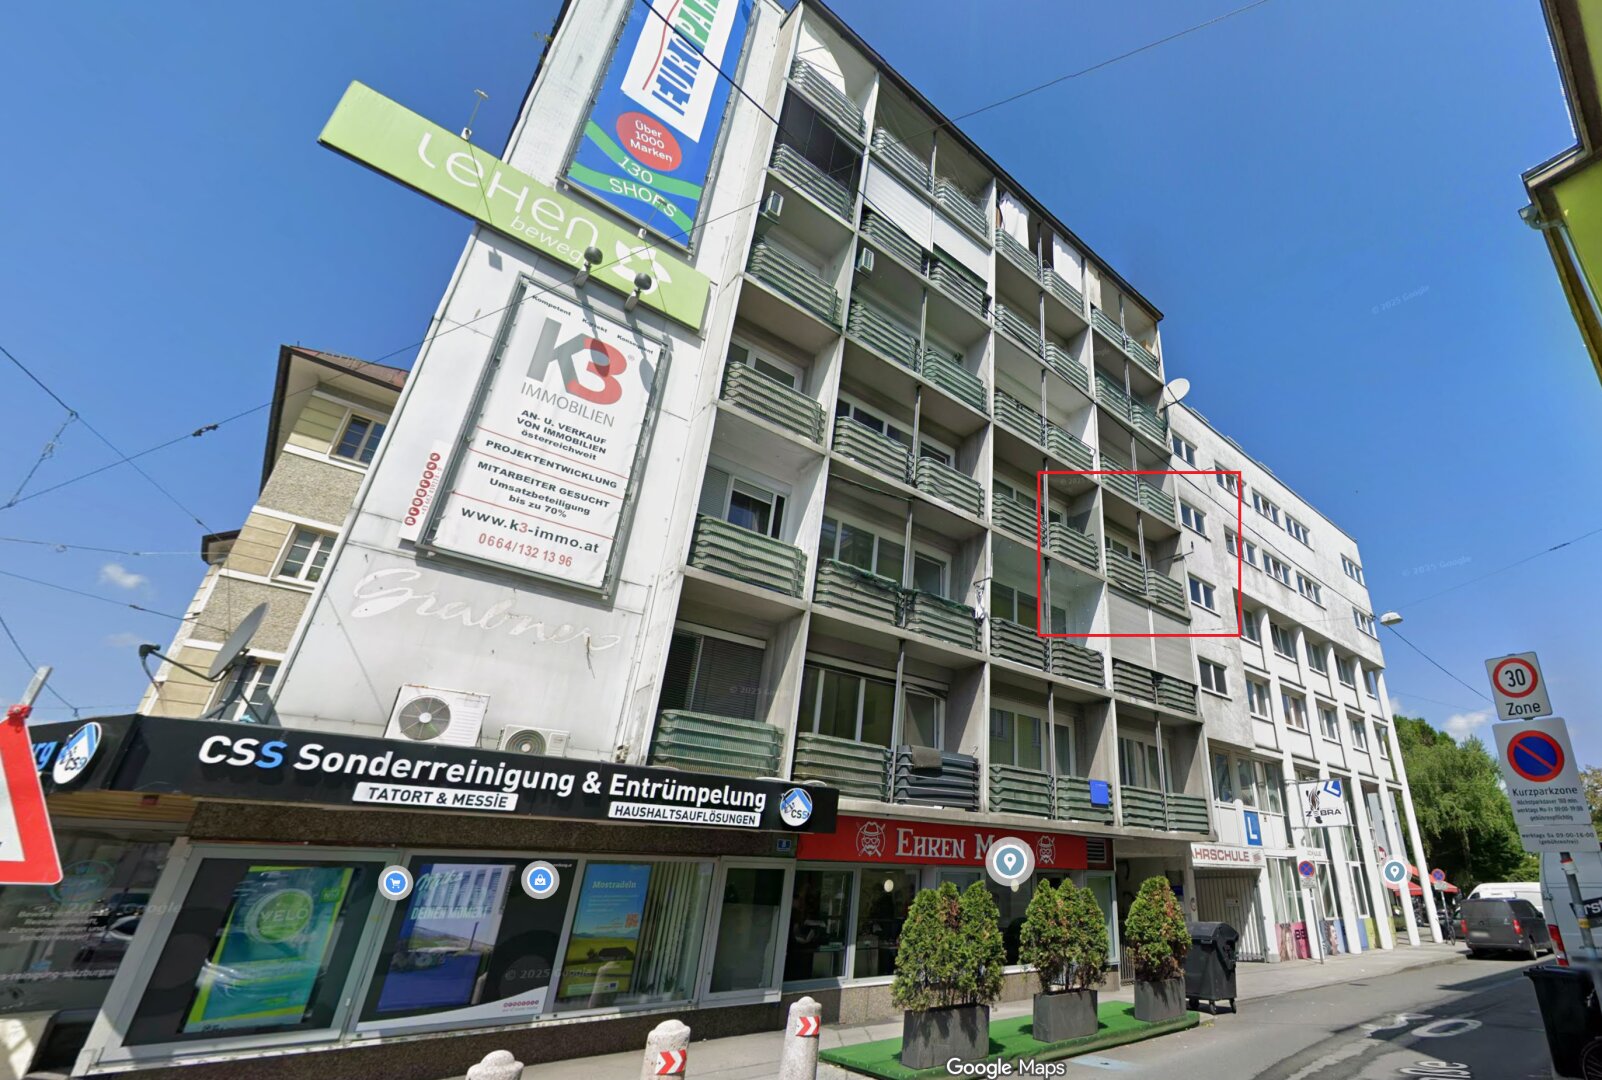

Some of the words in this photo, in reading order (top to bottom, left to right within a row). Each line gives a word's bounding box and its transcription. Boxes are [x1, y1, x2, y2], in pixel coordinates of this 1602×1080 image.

[634, 119, 663, 138] Über
[635, 131, 665, 150] 1000
[630, 139, 673, 163] Marken
[617, 155, 653, 185] 130
[609, 177, 677, 218] SHOPS
[532, 295, 572, 316] Kompetent
[526, 317, 628, 406] K3
[520, 381, 616, 428] IMMOBILIEN
[516, 417, 540, 431] VON
[543, 427, 607, 454] IMMOBILIEN
[521, 409, 540, 421] AN-
[543, 417, 555, 427] U.
[558, 422, 607, 445] VERKAUF
[521, 429, 597, 461] österreichweit
[485, 439, 617, 489] PROJEKTENTWICKLUNG
[477, 460, 557, 492] MITARBEITER
[559, 487, 611, 508] GESUCHT
[489, 477, 591, 516] Umsatzbeteiligung
[508, 494, 526, 506] bis
[528, 501, 542, 511] zu
[544, 504, 568, 518] 70%
[461, 507, 600, 553] www.k3-immo.at
[478, 532, 540, 559] 0664/132
[543, 550, 556, 563] 13
[558, 554, 573, 568] 96
[1504, 667, 1527, 688] 30
[1505, 701, 1542, 716] Zone
[198, 735, 288, 769] CSS
[293, 743, 576, 797] Sonderreinigung
[582, 771, 602, 794] &
[609, 773, 767, 813] Entrümpelung
[368, 786, 433, 804] TATORT
[435, 790, 447, 805] &
[1512, 787, 1578, 797] Kurzparkzone
[614, 804, 756, 826] HAUSHALTSAUFLÖSUNGEN
[791, 809, 809, 820] CSS
[1305, 808, 1342, 818] ZEBRA
[895, 828, 967, 859] EHREN
[592, 880, 637, 889] Mostradeln
[260, 907, 309, 922] VELO
